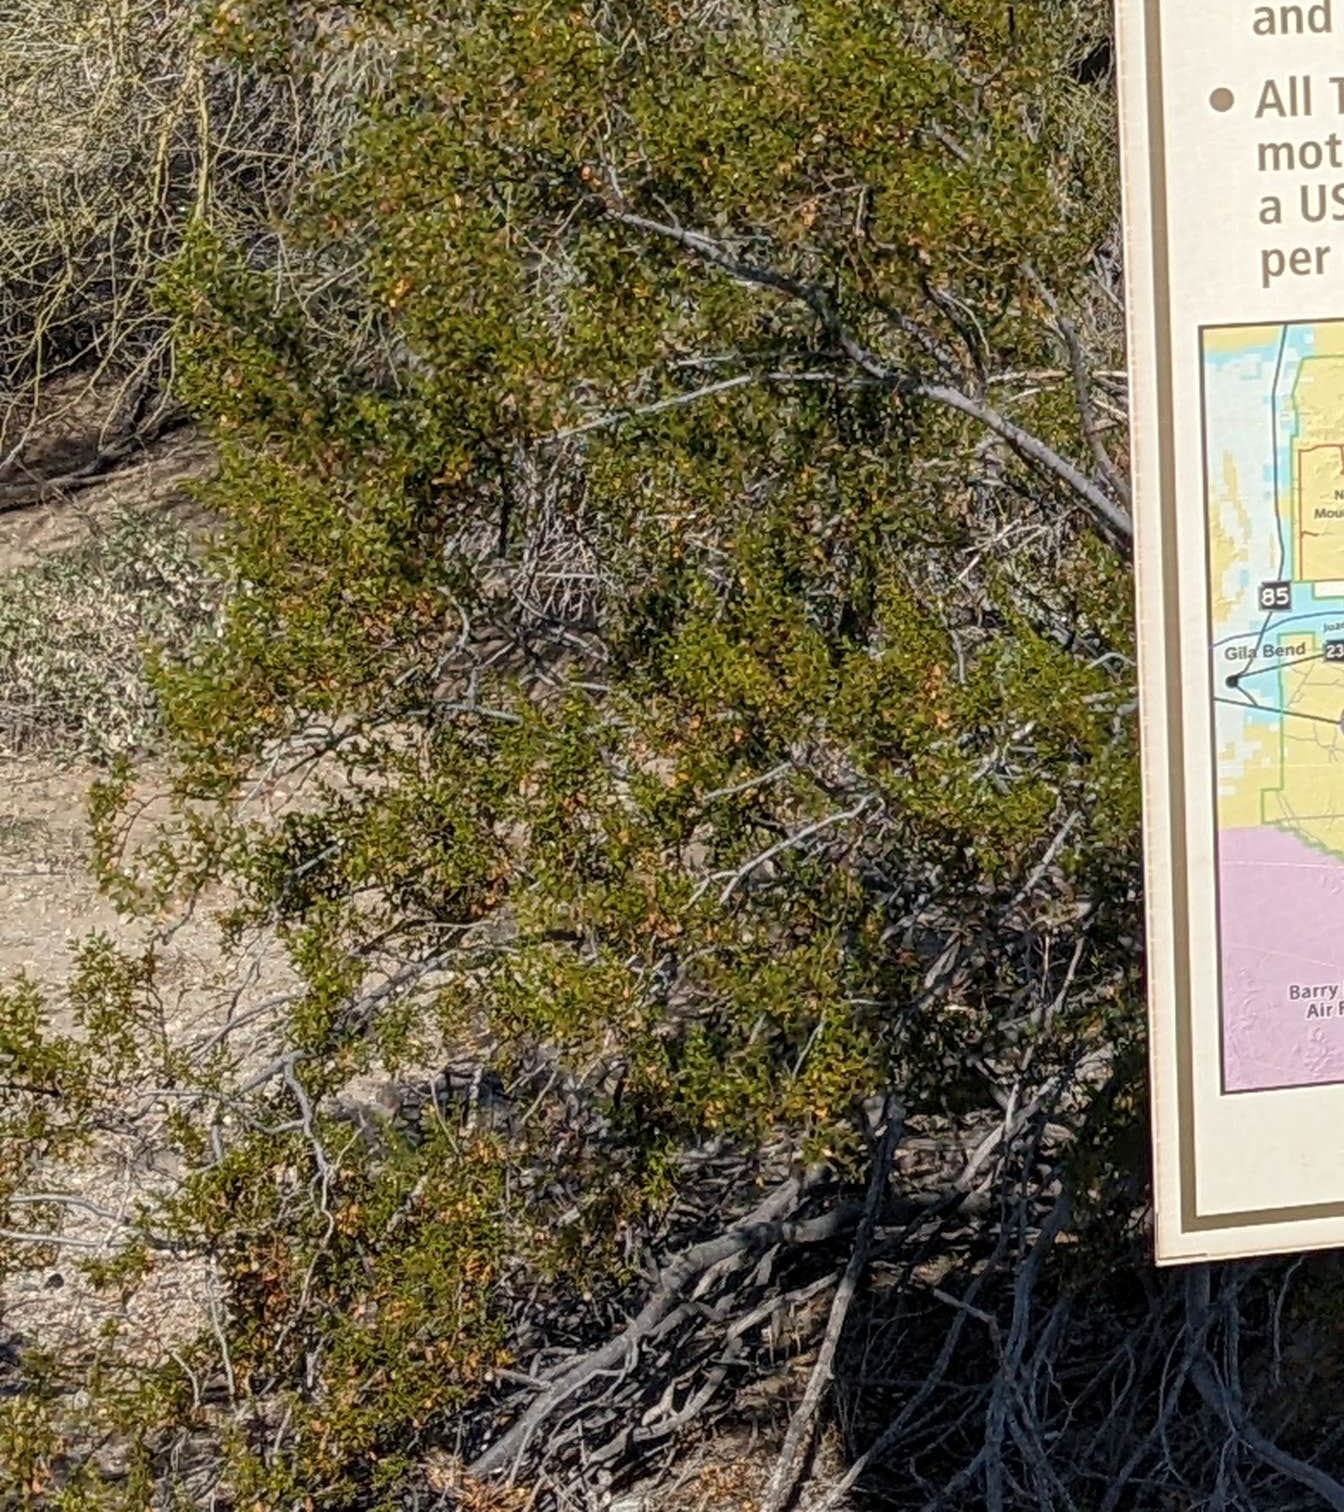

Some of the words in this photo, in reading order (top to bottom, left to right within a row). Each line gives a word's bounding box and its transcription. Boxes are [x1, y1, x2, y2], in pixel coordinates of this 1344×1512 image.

[1254, 74, 1312, 119] All
[1259, 196, 1282, 225] a
[1261, 588, 1289, 606] 85
[1225, 647, 1257, 661] Gila
[1263, 642, 1306, 658] Bend
[1289, 984, 1338, 1000] Barry
[1307, 1003, 1332, 1018] Air
